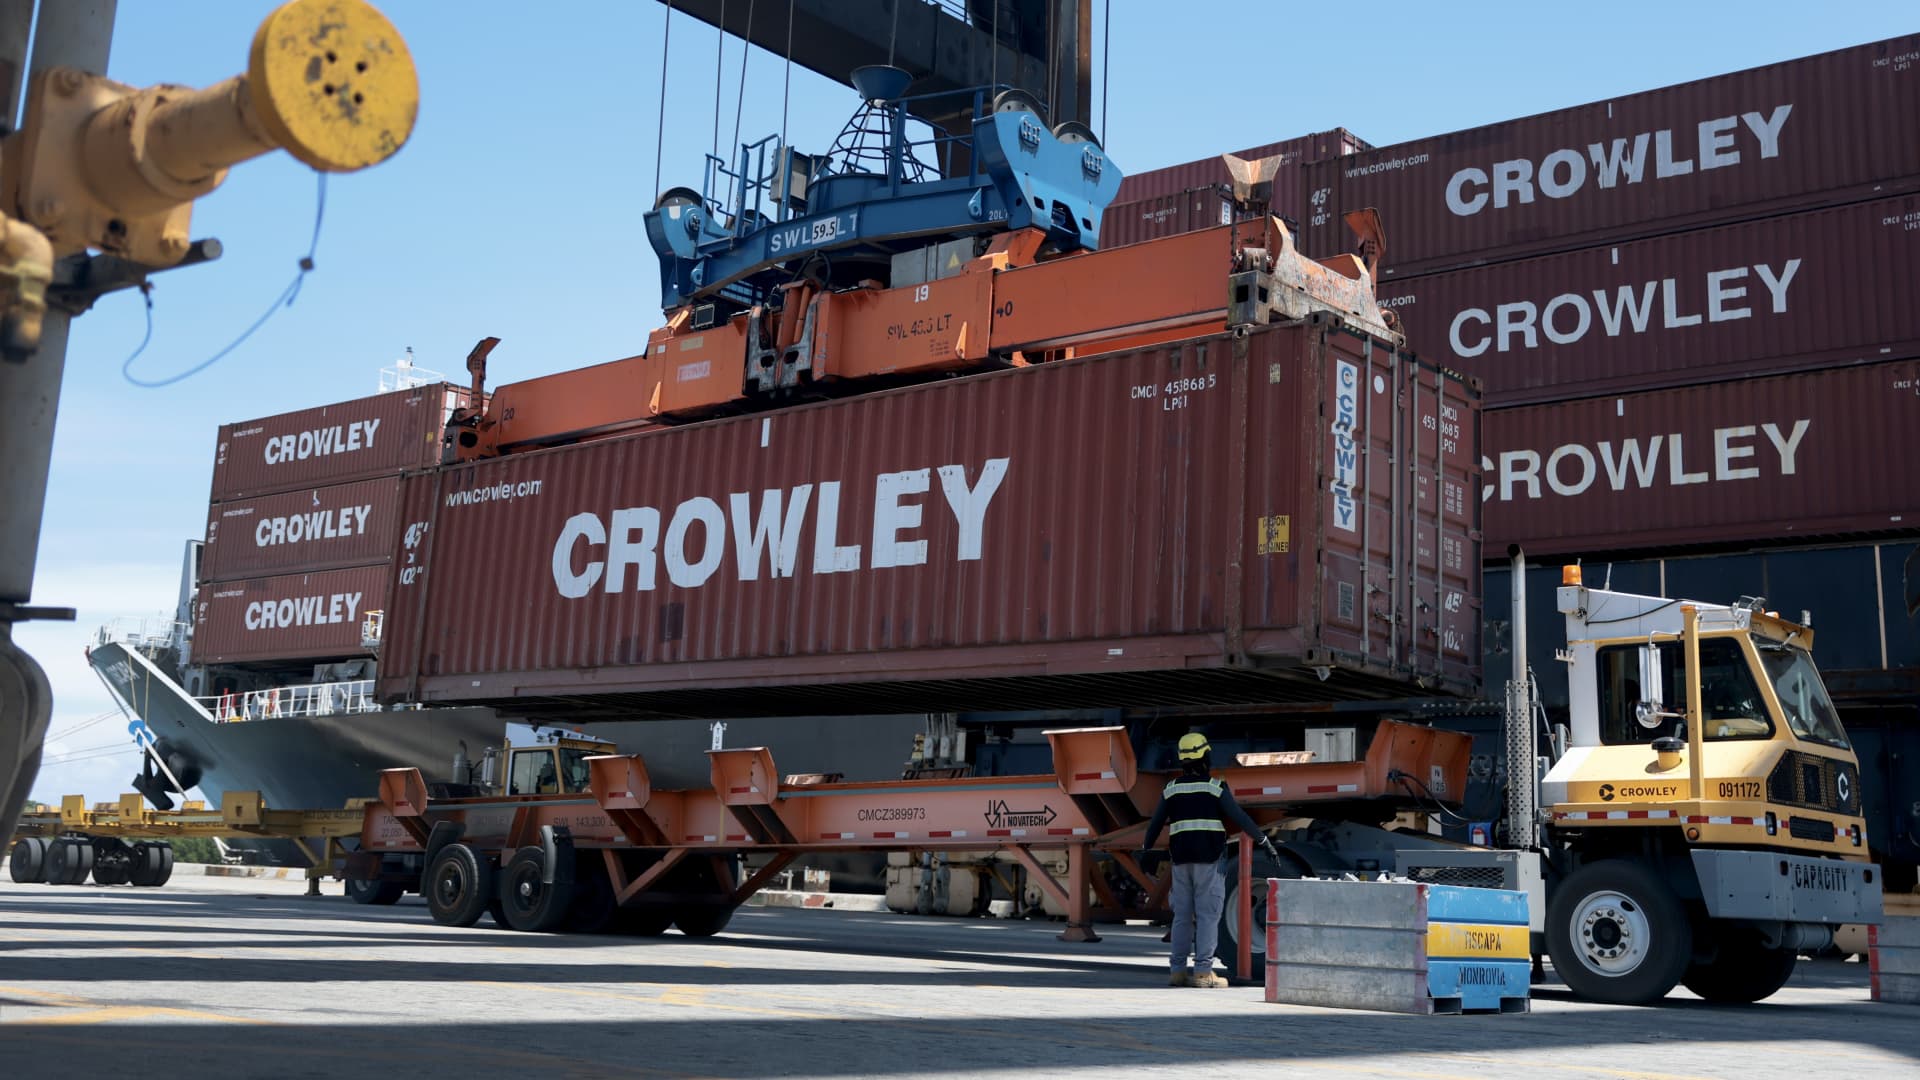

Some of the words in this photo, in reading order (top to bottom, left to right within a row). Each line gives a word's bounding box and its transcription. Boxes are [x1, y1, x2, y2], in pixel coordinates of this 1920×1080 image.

[1345, 153, 1429, 178] www.crowley.com
[1445, 104, 1793, 216] CROWLEY
[770, 226, 811, 252] SWL
[813, 221, 835, 240] 59.5
[915, 285, 929, 303] 19
[1449, 258, 1801, 357] CROWLEY
[937, 313, 952, 331] LT
[1131, 384, 1158, 399] CMCU
[265, 419, 380, 465] CROWLEY
[1335, 394, 1355, 525] CROWLEY
[255, 505, 371, 547] CROWLEY
[552, 457, 1010, 598] CROWLEY
[245, 592, 362, 630] CROWLEY
[1620, 786, 1677, 797] CROWLEY
[1719, 782, 1760, 798] 091172
[858, 807, 926, 821] CMCZ389973
[1007, 815, 1044, 827] NOVATECH
[1795, 864, 1848, 892] CAPACITY
[1464, 931, 1502, 951] TISCAPA
